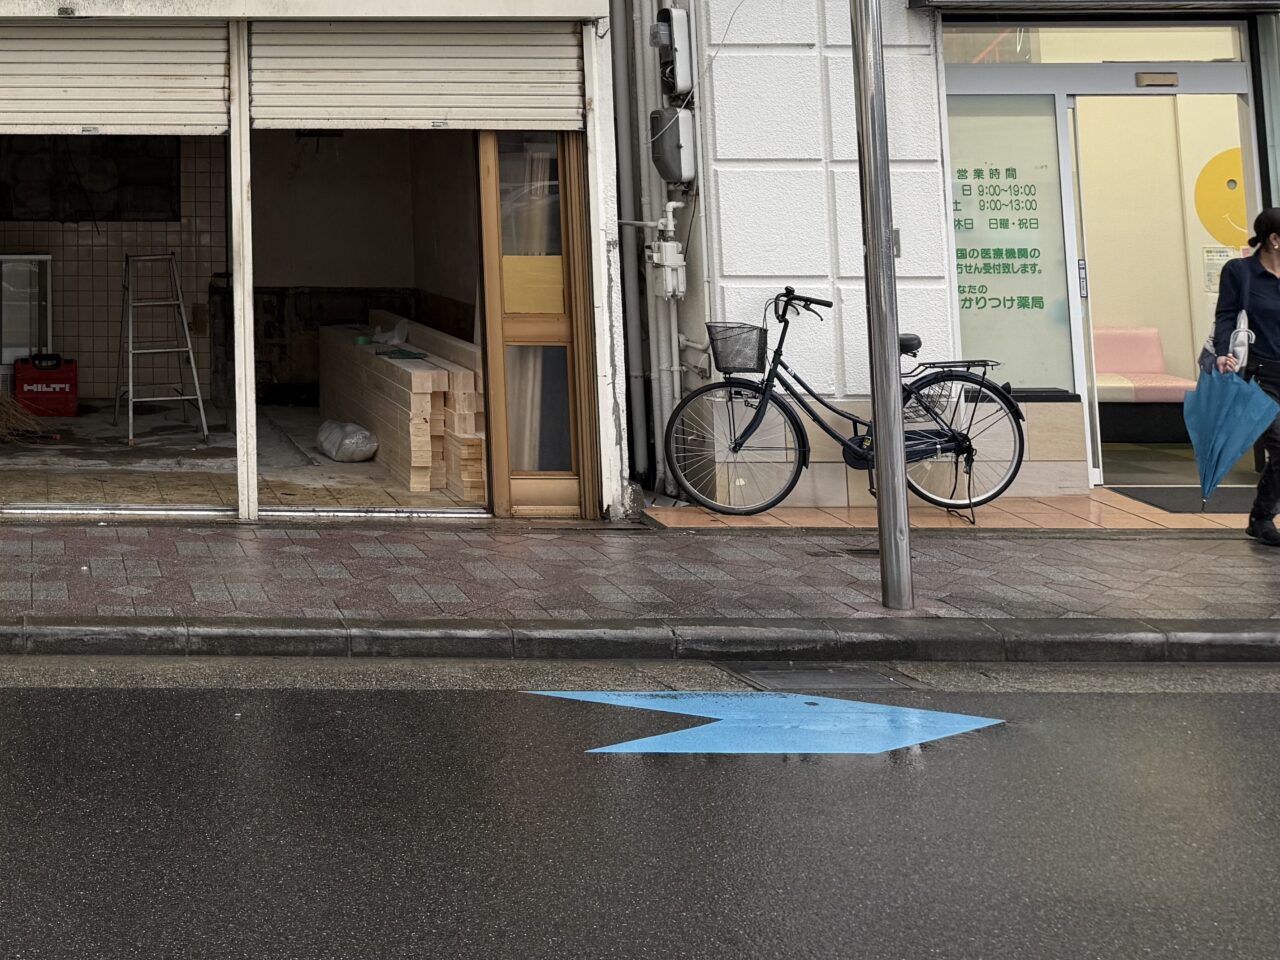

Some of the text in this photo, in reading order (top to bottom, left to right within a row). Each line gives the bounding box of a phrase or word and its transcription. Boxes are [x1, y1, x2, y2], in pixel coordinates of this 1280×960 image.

[956, 168, 1017, 180] 営業時間
[23, 383, 70, 392] HILTI
